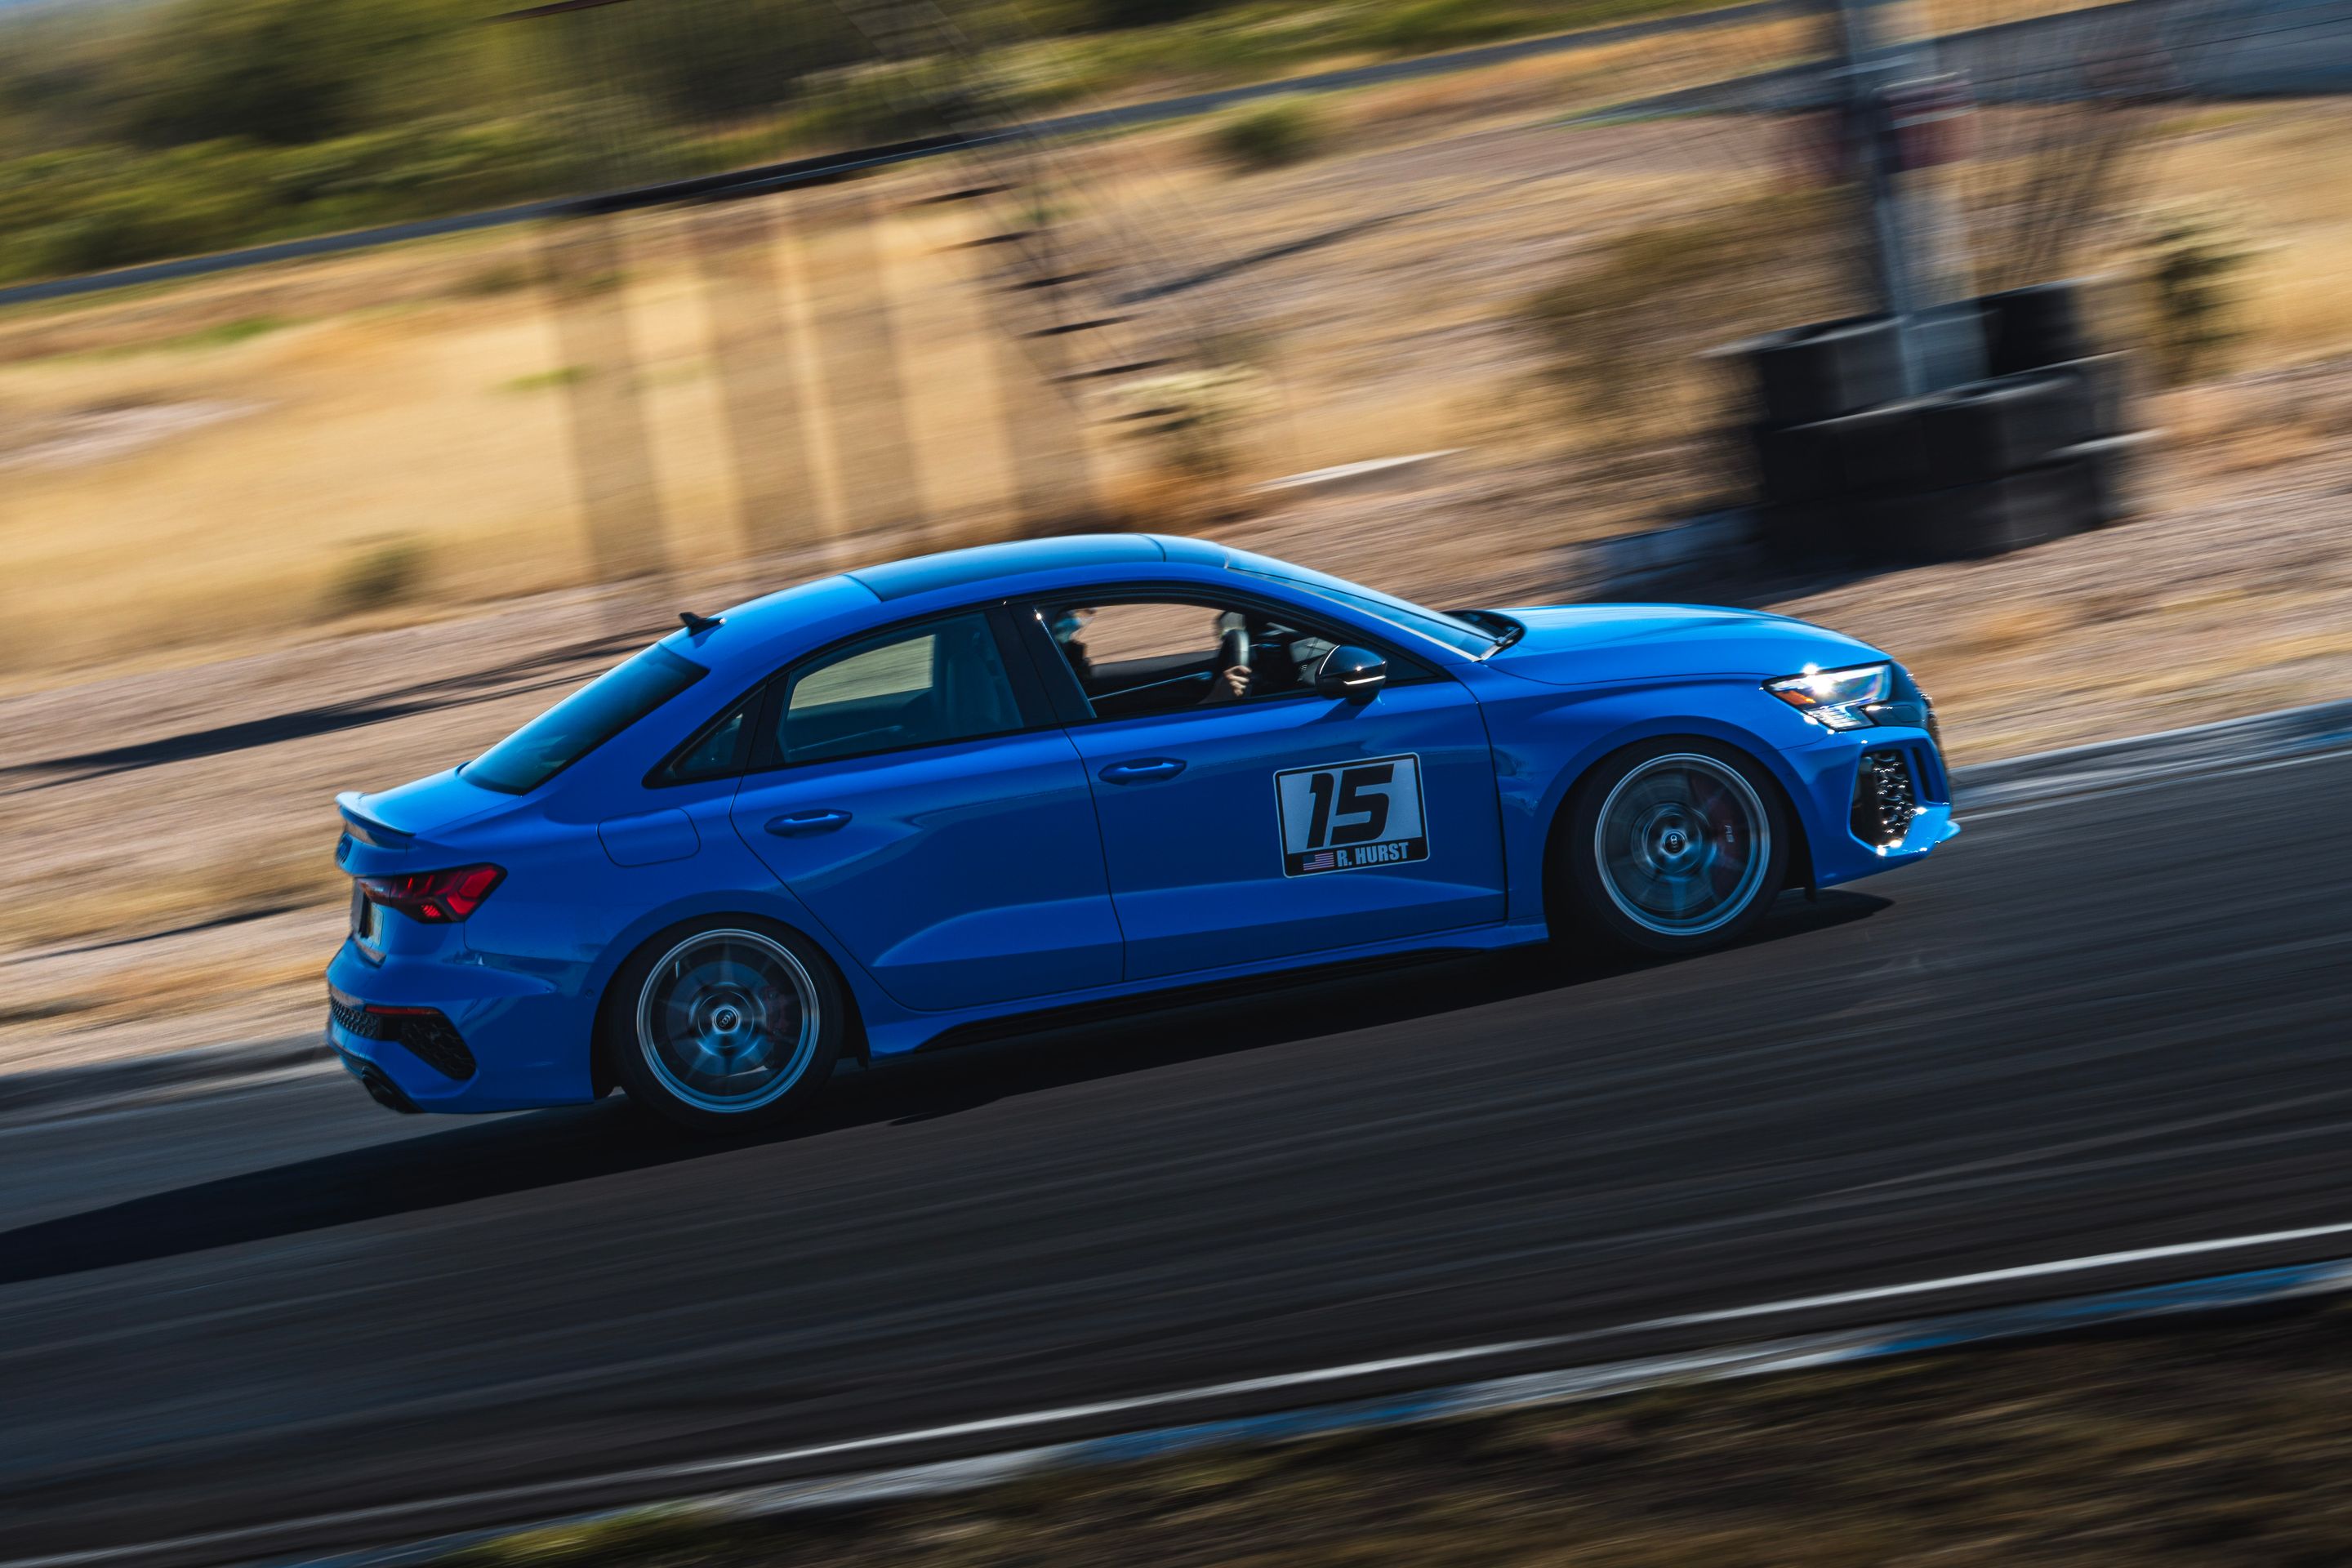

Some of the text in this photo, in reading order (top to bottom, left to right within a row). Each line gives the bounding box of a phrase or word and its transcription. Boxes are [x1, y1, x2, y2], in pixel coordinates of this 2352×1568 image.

[1307, 764, 1395, 849] 15
[1336, 842, 1410, 867] R. HURST
